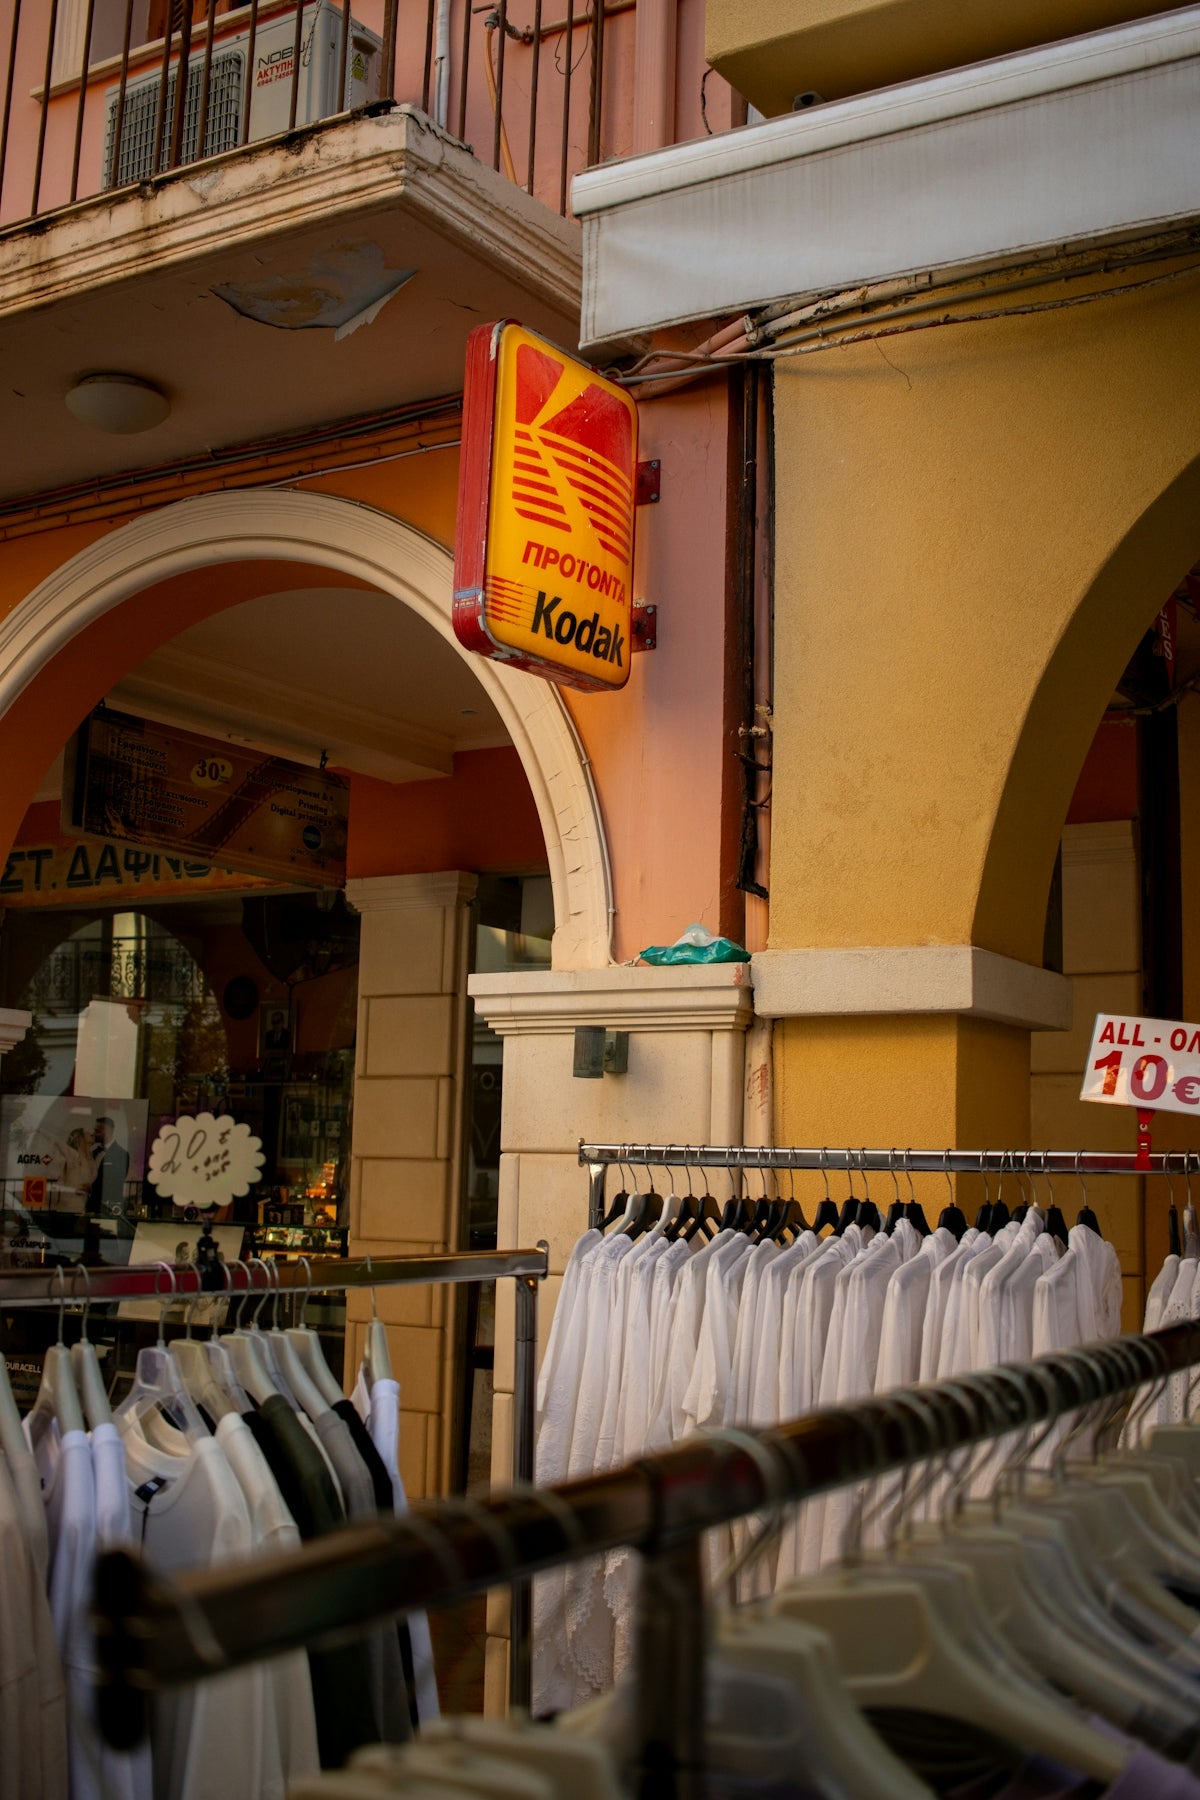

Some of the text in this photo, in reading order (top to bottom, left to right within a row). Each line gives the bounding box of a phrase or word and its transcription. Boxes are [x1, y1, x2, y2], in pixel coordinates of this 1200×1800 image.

[530, 590, 625, 668] Kodak
[270, 803, 297, 818] Digital
[298, 799, 329, 816] Printing
[1098, 1021, 1146, 1047] ALL
[17, 1154, 41, 1165] AGFA
[9, 1238, 52, 1250] OLYMPUS
